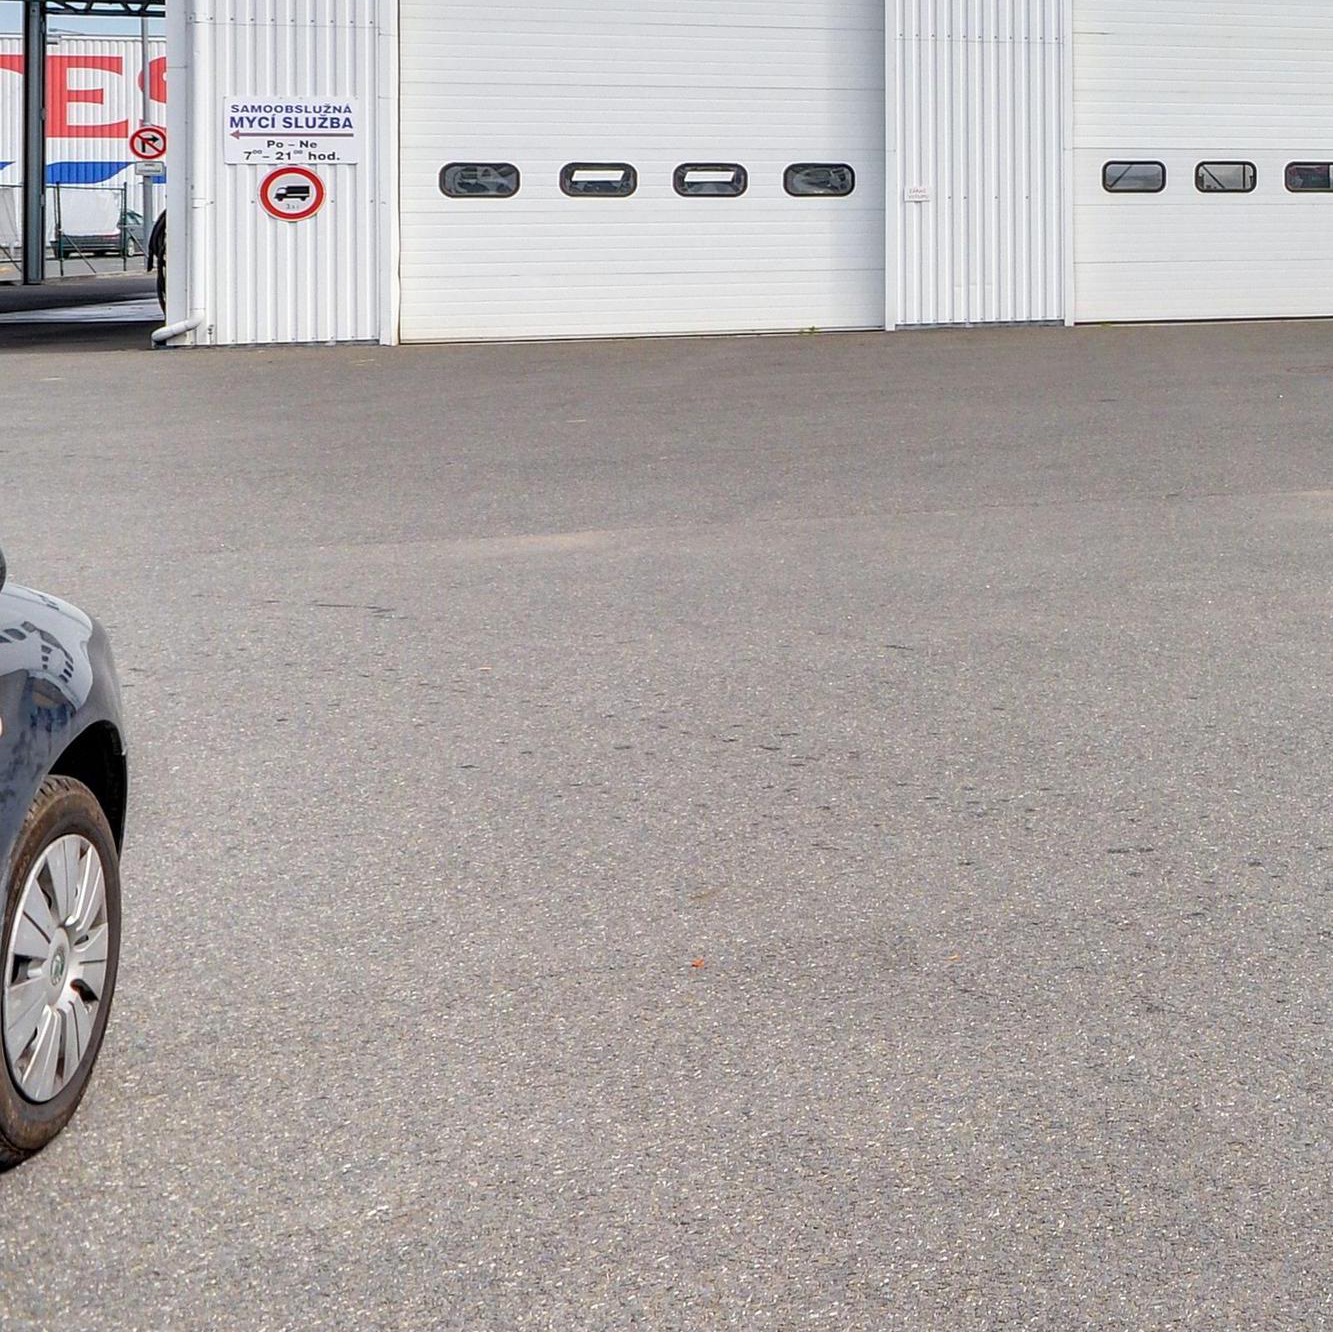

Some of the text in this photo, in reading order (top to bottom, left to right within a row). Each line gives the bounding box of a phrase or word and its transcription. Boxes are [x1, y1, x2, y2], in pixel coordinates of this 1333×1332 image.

[231, 103, 353, 114] SAMOOBSLUŽNÁ
[230, 114, 353, 128] MYCÍ SLUŽBA
[267, 140, 284, 149] Po
[300, 140, 317, 149] Ne
[308, 151, 340, 161] hod.
